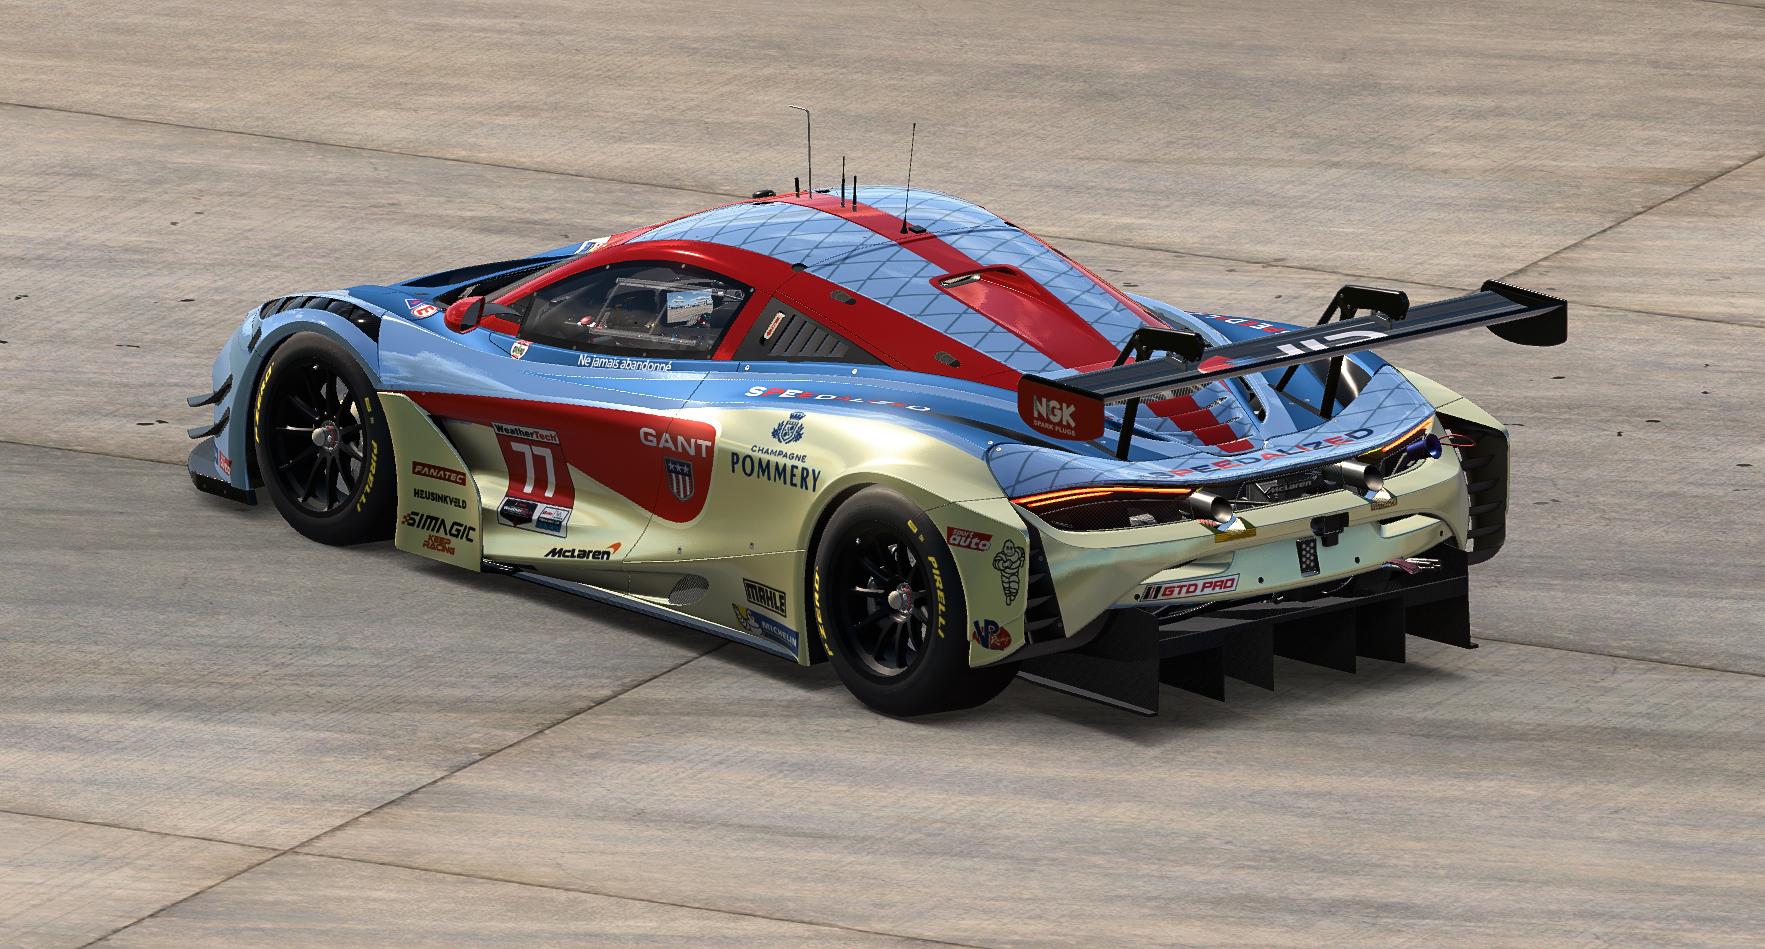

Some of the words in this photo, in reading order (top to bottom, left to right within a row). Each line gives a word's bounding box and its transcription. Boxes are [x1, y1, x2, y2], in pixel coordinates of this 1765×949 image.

[578, 354, 591, 366] Ne
[591, 355, 619, 368] jamais
[620, 358, 672, 372] abandonné
[1033, 394, 1076, 428] NGK
[494, 423, 558, 442] WeatherTech
[1034, 420, 1054, 431] SPARK
[1055, 425, 1076, 437] PLUGS
[639, 427, 712, 458] GANT
[751, 445, 807, 463] CHAMPAGNE
[357, 440, 378, 512] PIRELLI
[414, 465, 464, 483] FANATEC
[511, 441, 556, 497] 77
[731, 452, 821, 492] POMMERY
[413, 488, 467, 510] HEUSINKVELD
[406, 511, 476, 542] SIMAGIC
[423, 540, 455, 555] RACING
[428, 534, 451, 546] KEEP
[950, 535, 991, 550] auto
[745, 582, 785, 614] MAHLE
[928, 556, 945, 638] PIRELLI
[1162, 583, 1198, 597] GTD
[1200, 578, 1236, 592] PRO
[761, 621, 797, 647] MICHELIN
